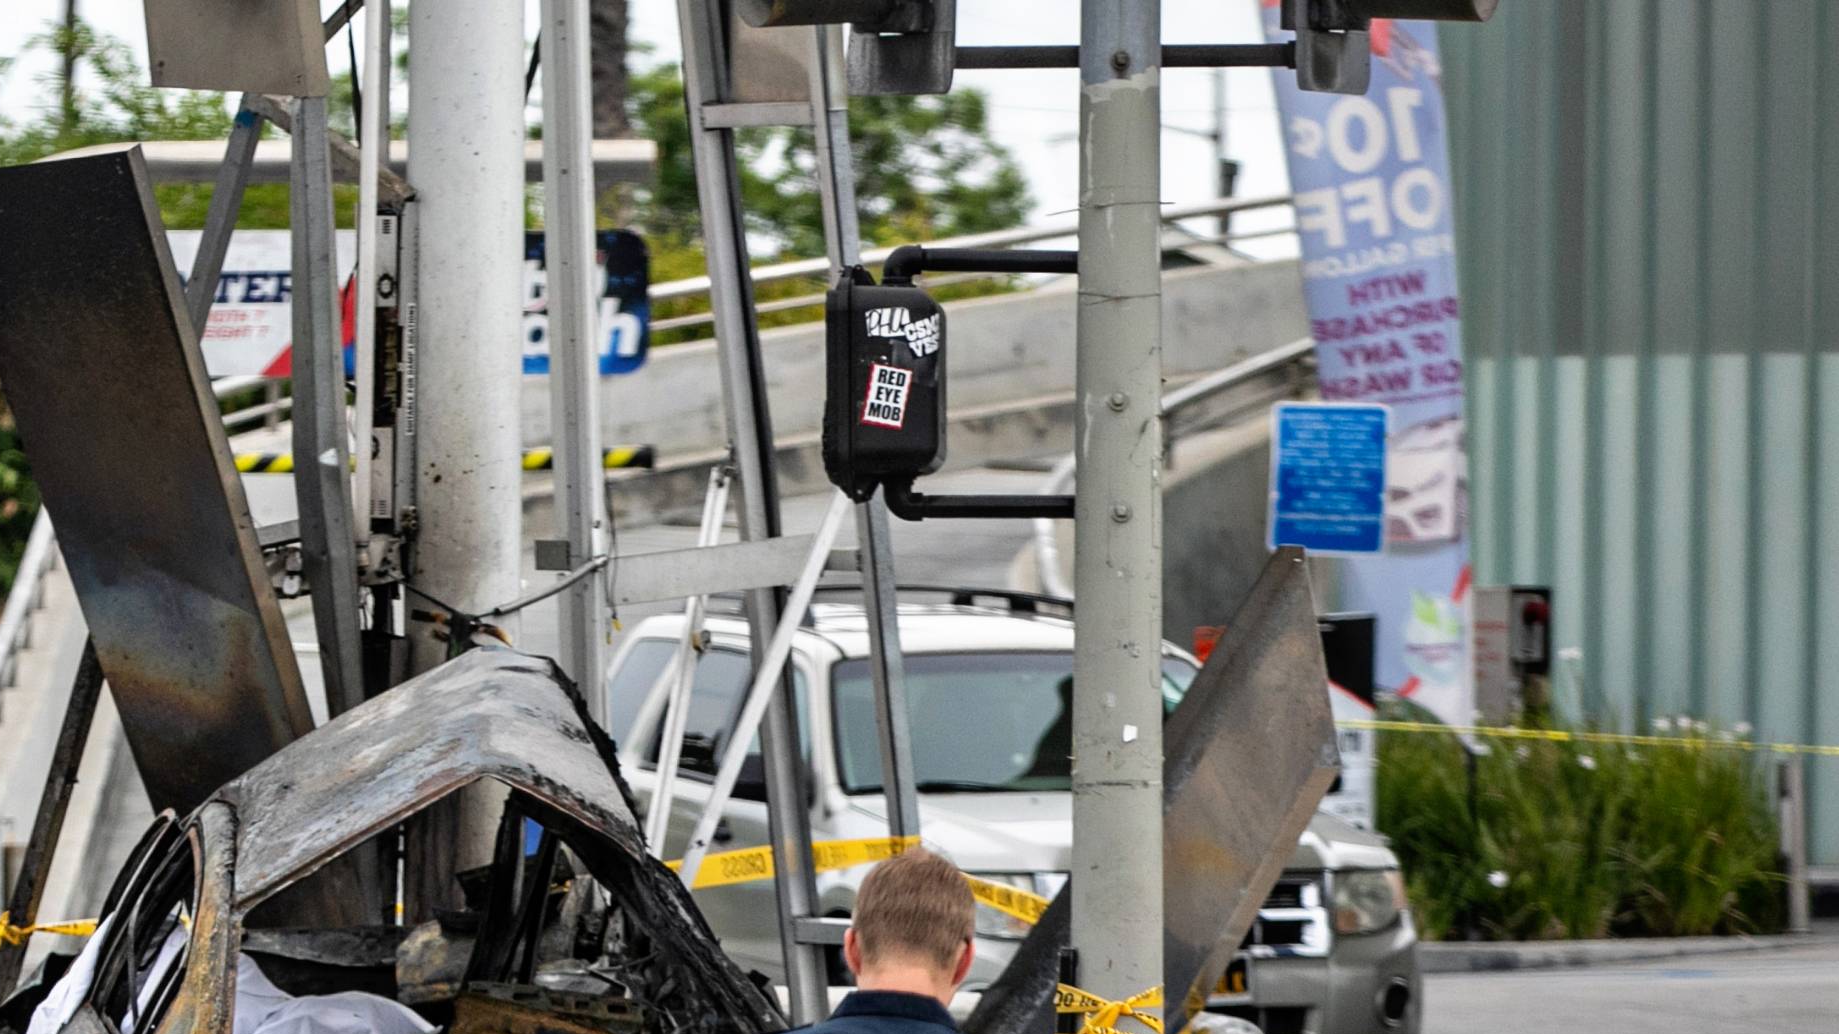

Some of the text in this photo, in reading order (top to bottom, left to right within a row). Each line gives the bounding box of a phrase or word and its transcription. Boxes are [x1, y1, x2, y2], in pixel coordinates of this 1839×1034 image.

[877, 368, 906, 387] RED
[875, 387, 902, 404] EYE
[868, 402, 901, 421] MOB
